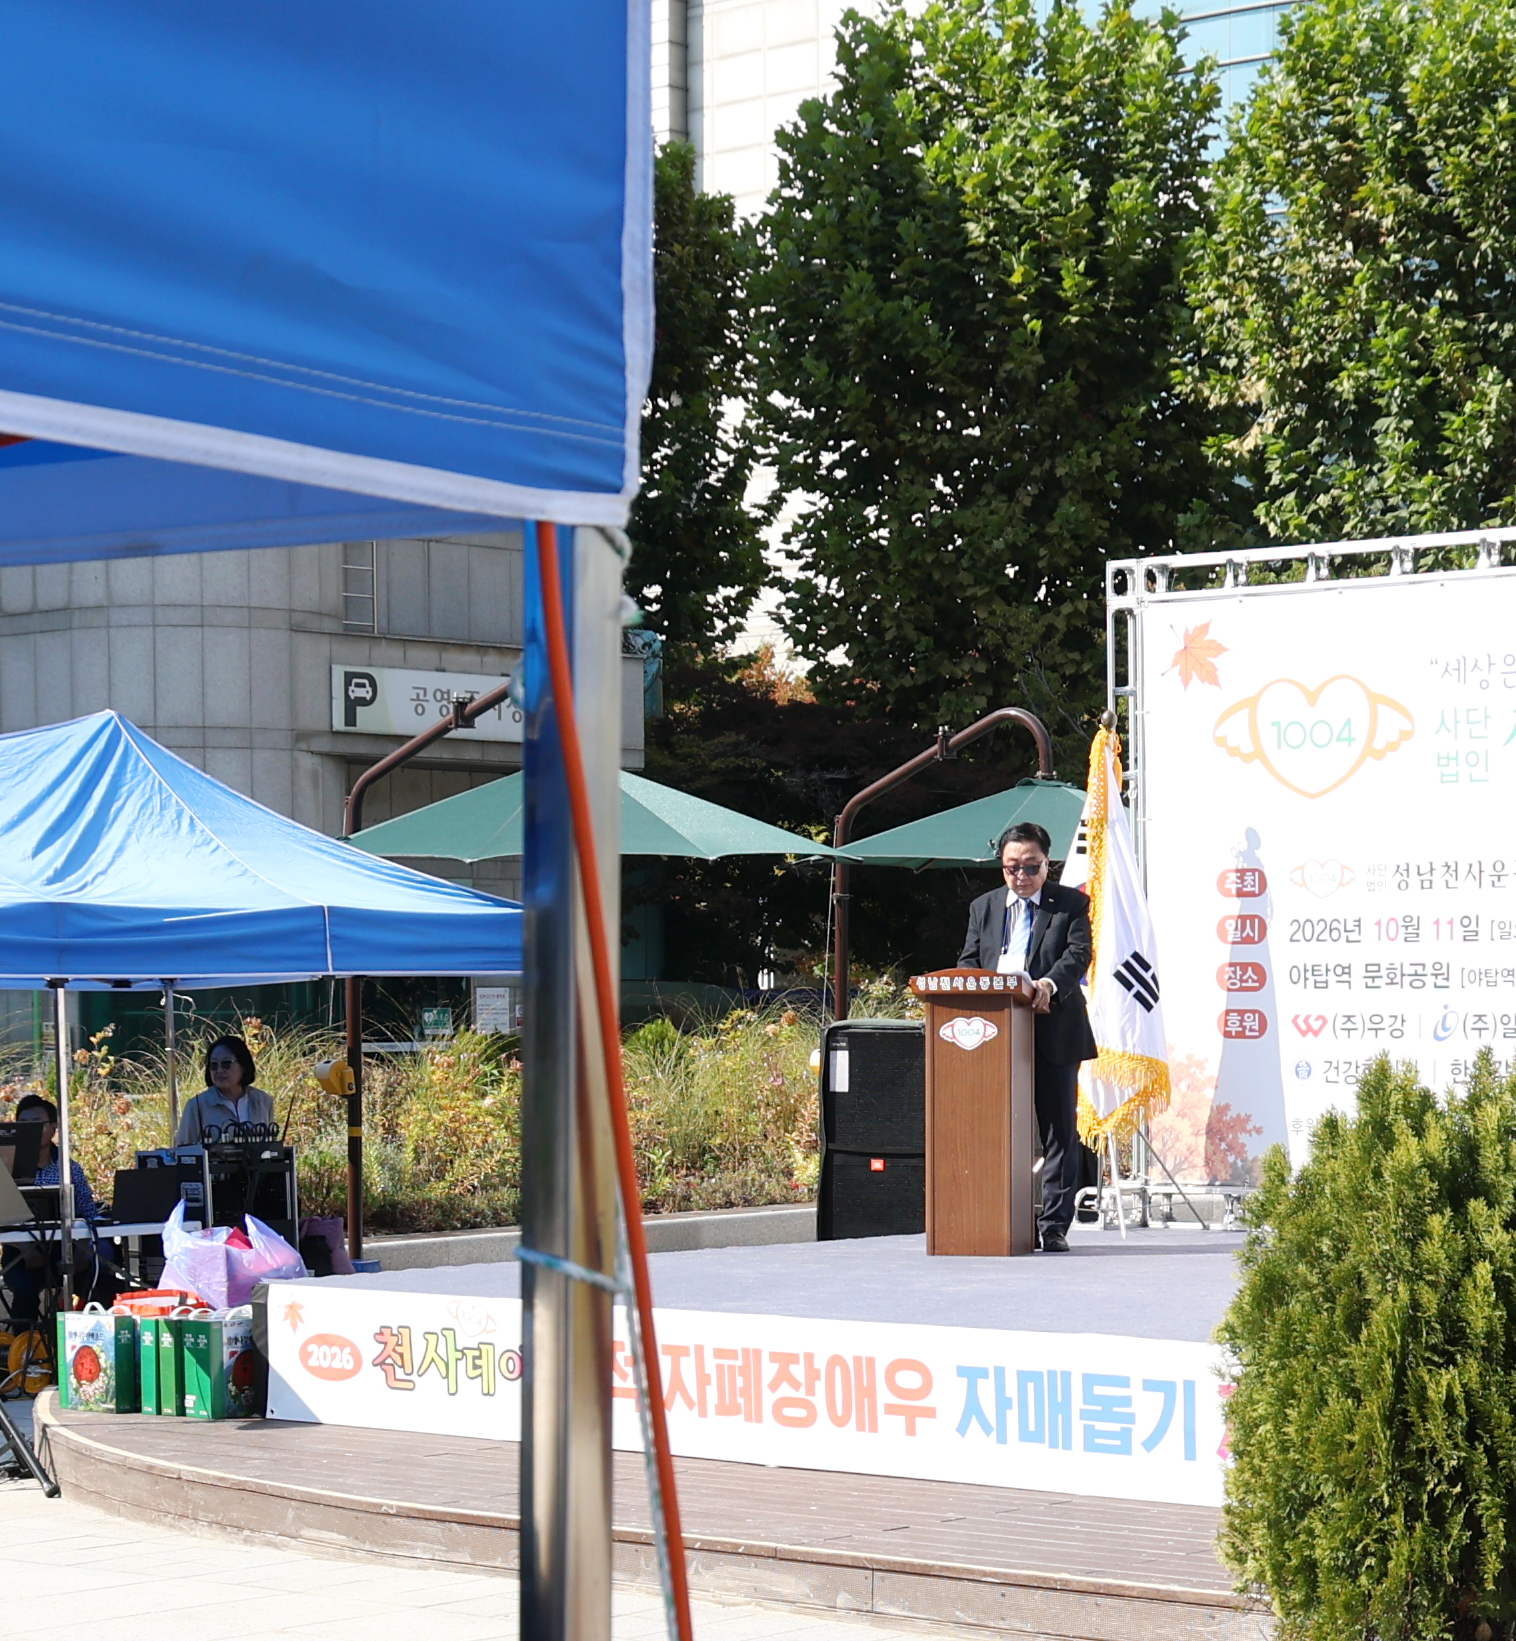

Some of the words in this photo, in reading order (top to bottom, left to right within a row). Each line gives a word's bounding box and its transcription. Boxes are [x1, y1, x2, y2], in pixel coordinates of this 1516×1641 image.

[344, 671, 378, 727] P
[1271, 717, 1357, 750] 1004
[1434, 704, 1491, 740] 사단
[1436, 749, 1489, 784] 법인
[1309, 872, 1337, 884] 1004
[1366, 864, 1388, 877] 사단
[1224, 872, 1260, 895] 주최
[1366, 880, 1388, 893] 법인
[1224, 918, 1260, 941] 일시
[1289, 915, 1362, 944] 2026년
[1374, 914, 1422, 943] 10월
[1432, 913, 1481, 942] 11일
[1224, 965, 1260, 988] 장소
[1289, 962, 1352, 990] 야탑역
[1363, 961, 1451, 990] 문화공원
[957, 1028, 981, 1037] 1004
[1224, 1012, 1261, 1036] 후원
[1332, 1012, 1407, 1040] (주)우강
[461, 1310, 483, 1327] 1004
[307, 1343, 355, 1371] 2026
[660, 1343, 938, 1438] 자폐장애우
[955, 1363, 1198, 1462] 자매돕기
